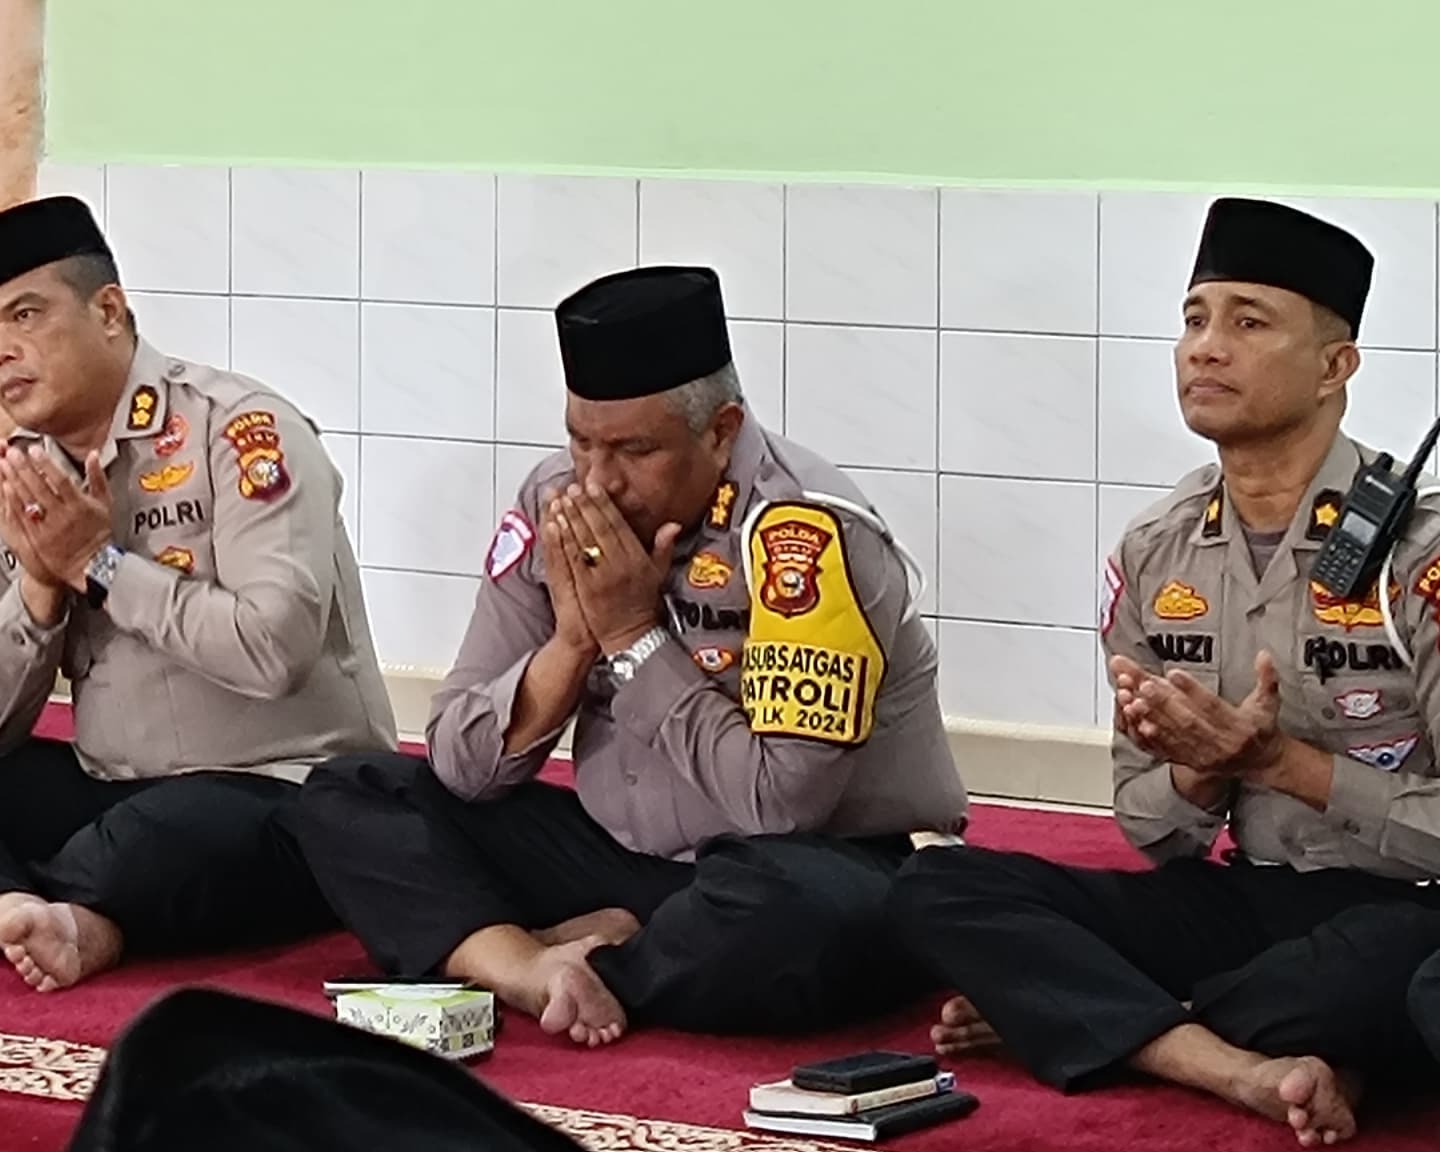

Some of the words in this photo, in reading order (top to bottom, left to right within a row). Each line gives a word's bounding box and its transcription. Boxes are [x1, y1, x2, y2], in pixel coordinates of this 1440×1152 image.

[134, 499, 205, 535] POLRI
[768, 527, 821, 545] POLDA
[1303, 636, 1404, 671] POLRI
[763, 707, 784, 725] LK
[796, 709, 847, 736] 2024
